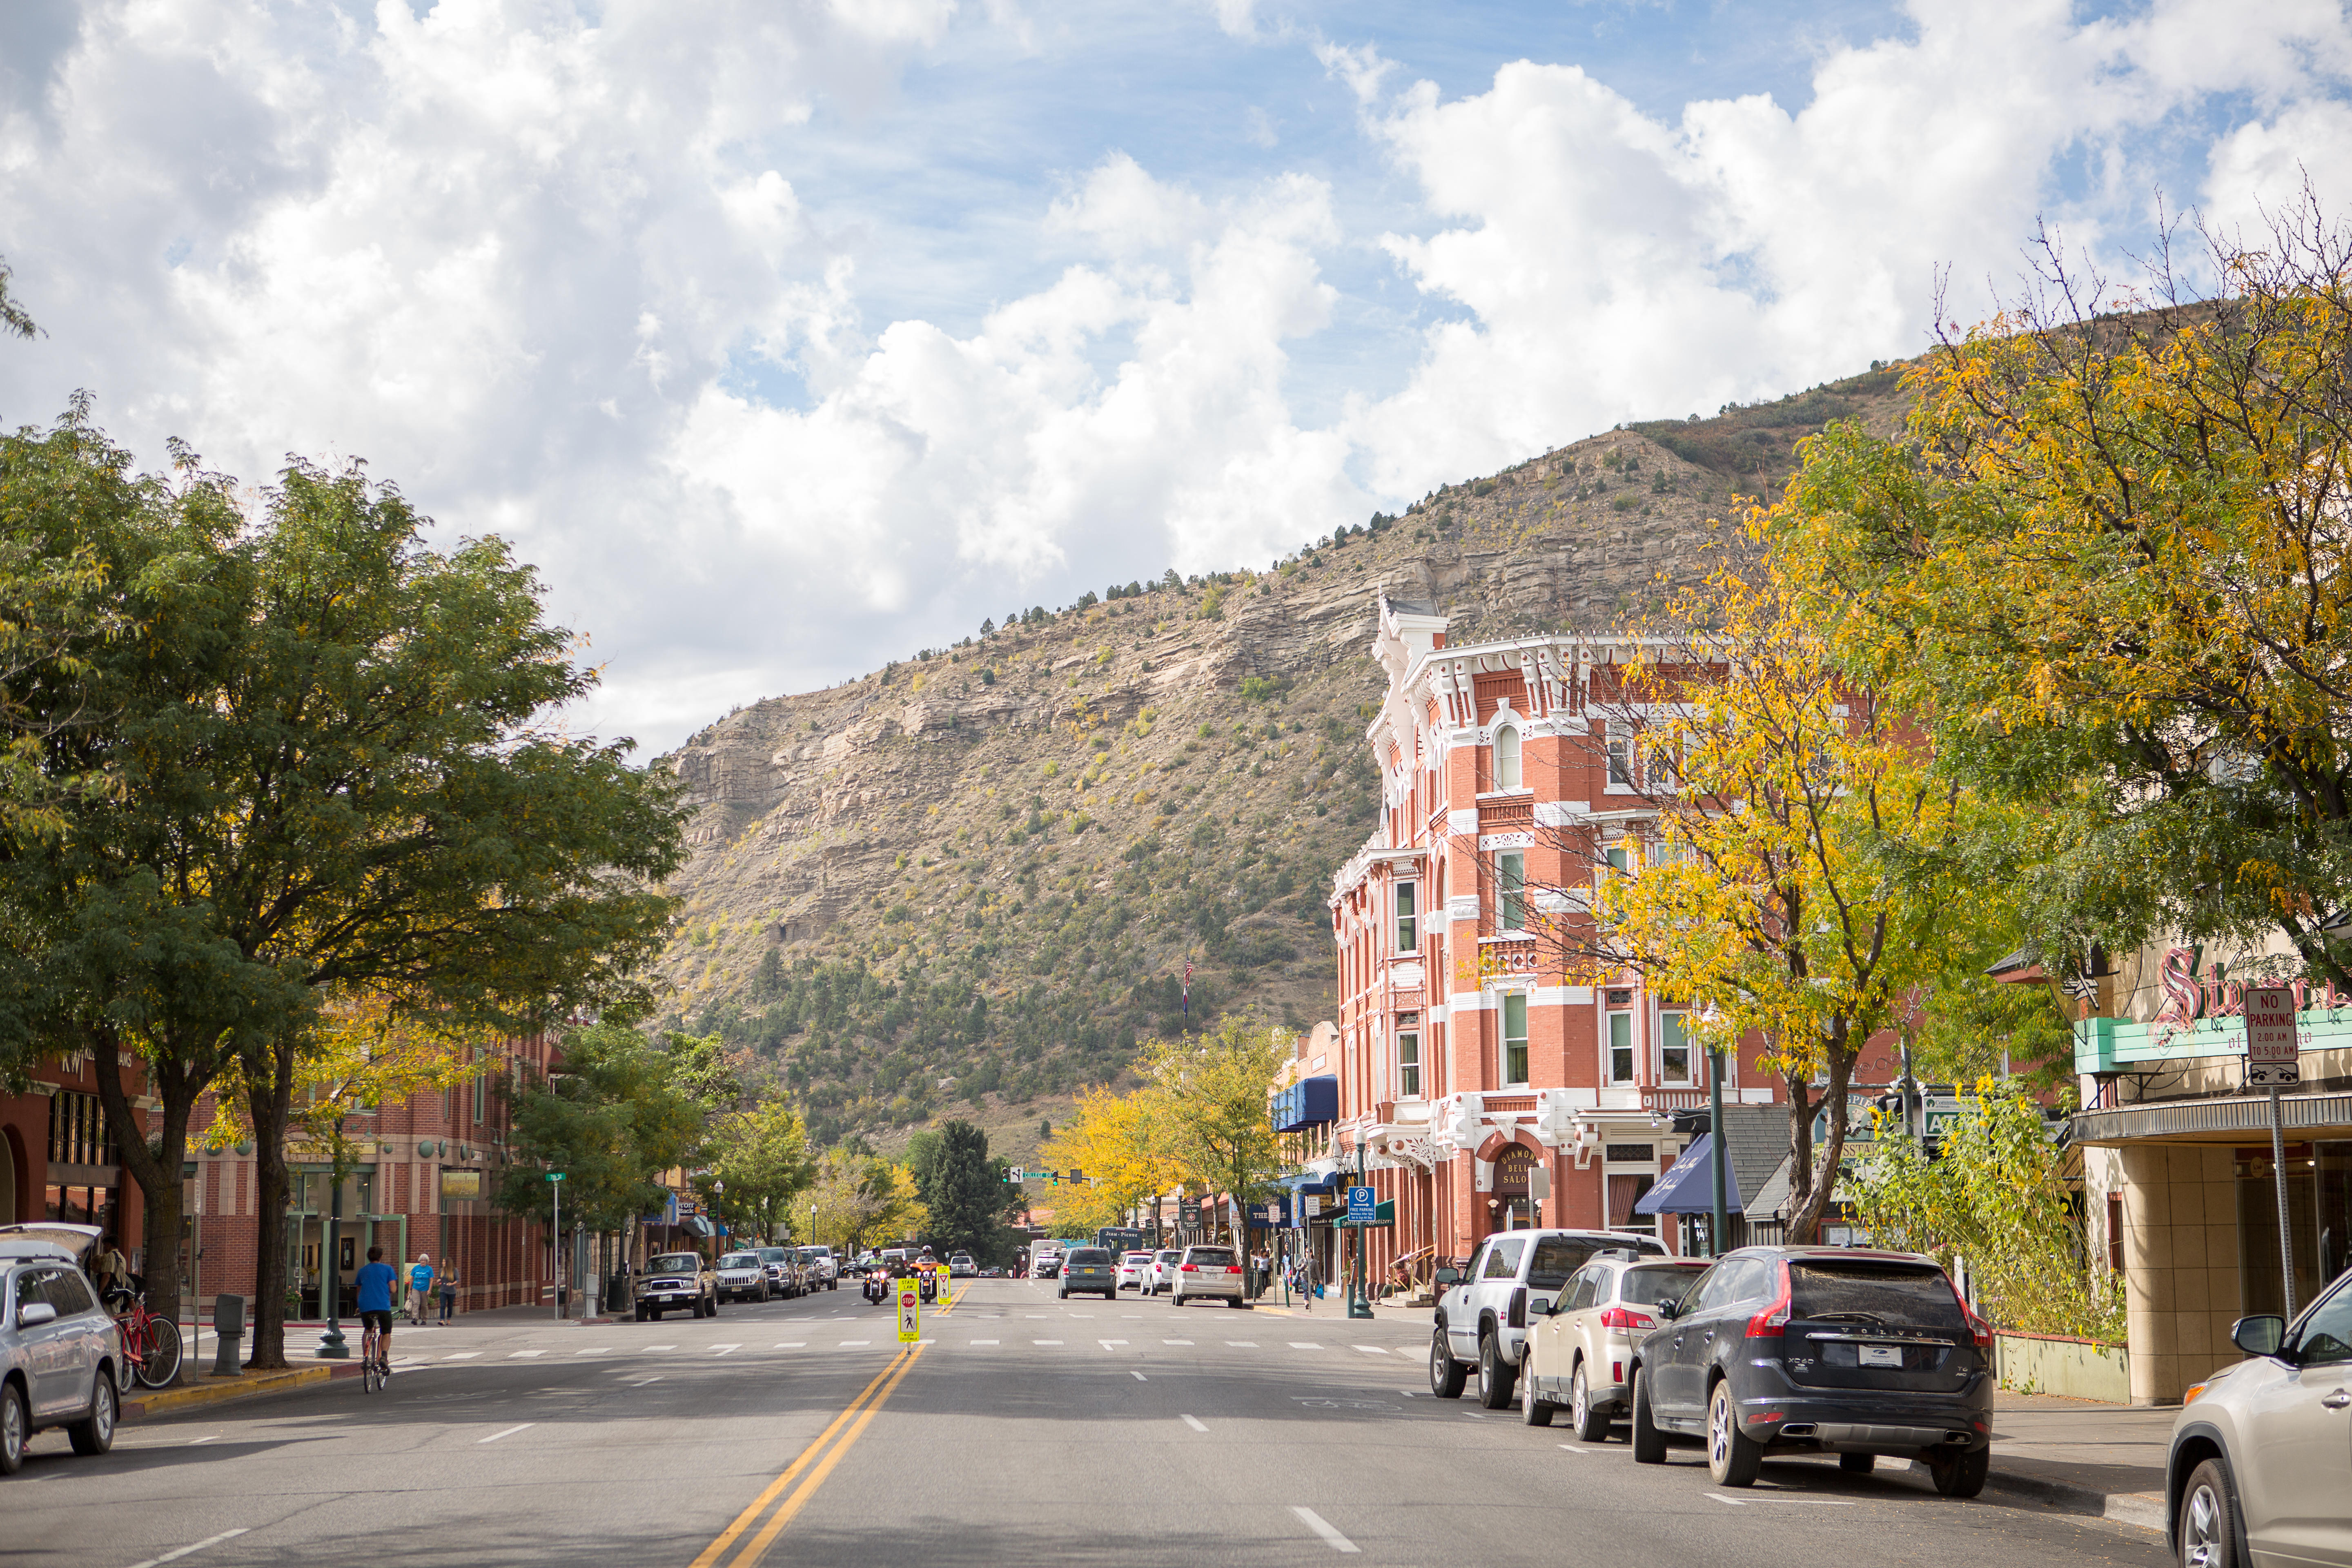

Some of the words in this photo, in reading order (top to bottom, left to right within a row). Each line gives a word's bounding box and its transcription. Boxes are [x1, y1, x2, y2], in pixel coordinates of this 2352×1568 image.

[2261, 995, 2278, 1009] NO
[2250, 1013, 2292, 1027] PARKING
[2258, 1033, 2274, 1042] 2:00
[2277, 1032, 2287, 1041] AM
[2253, 1047, 2261, 1055] TO
[2265, 1046, 2281, 1055] 5:00
[2284, 1046, 2294, 1055] AM
[446, 1176, 476, 1186] Jewelry
[1841, 1327, 1923, 1337] VOLVO
